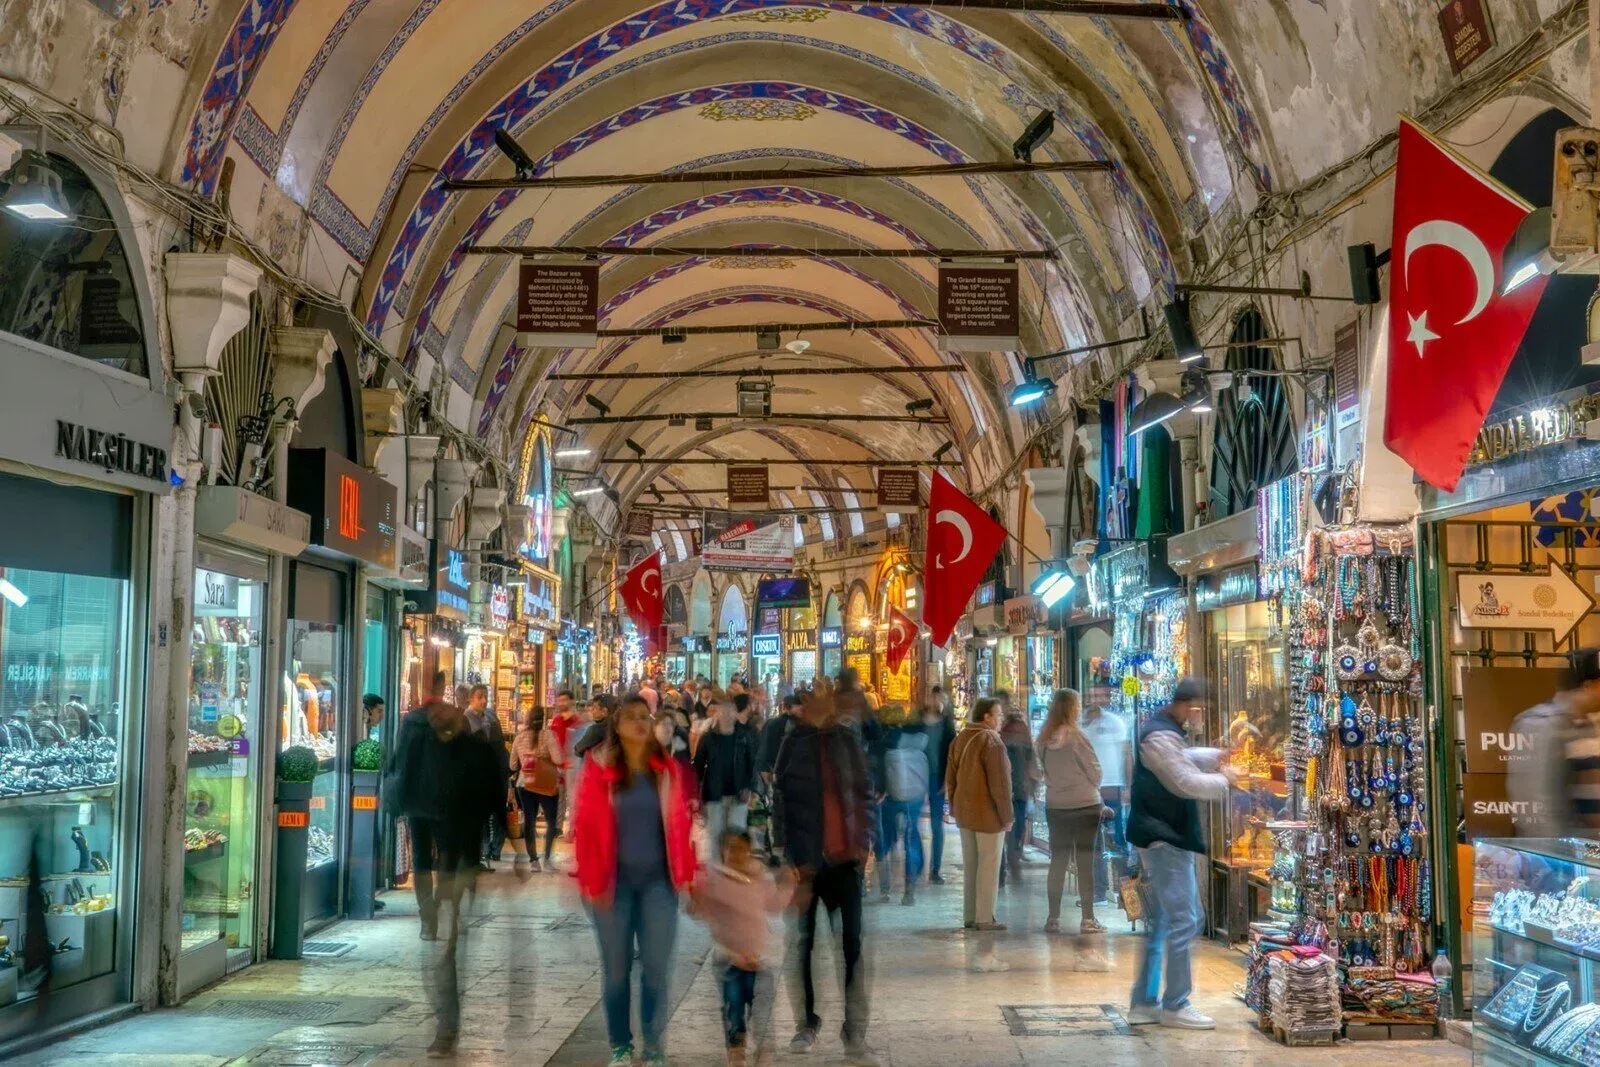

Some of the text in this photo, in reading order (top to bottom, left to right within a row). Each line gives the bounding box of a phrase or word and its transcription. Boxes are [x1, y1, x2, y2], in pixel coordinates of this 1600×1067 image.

[946, 312, 966, 320] largest
[204, 572, 225, 606] Sara
[791, 632, 808, 649] ALYA
[1473, 801, 1530, 815] SAINT
